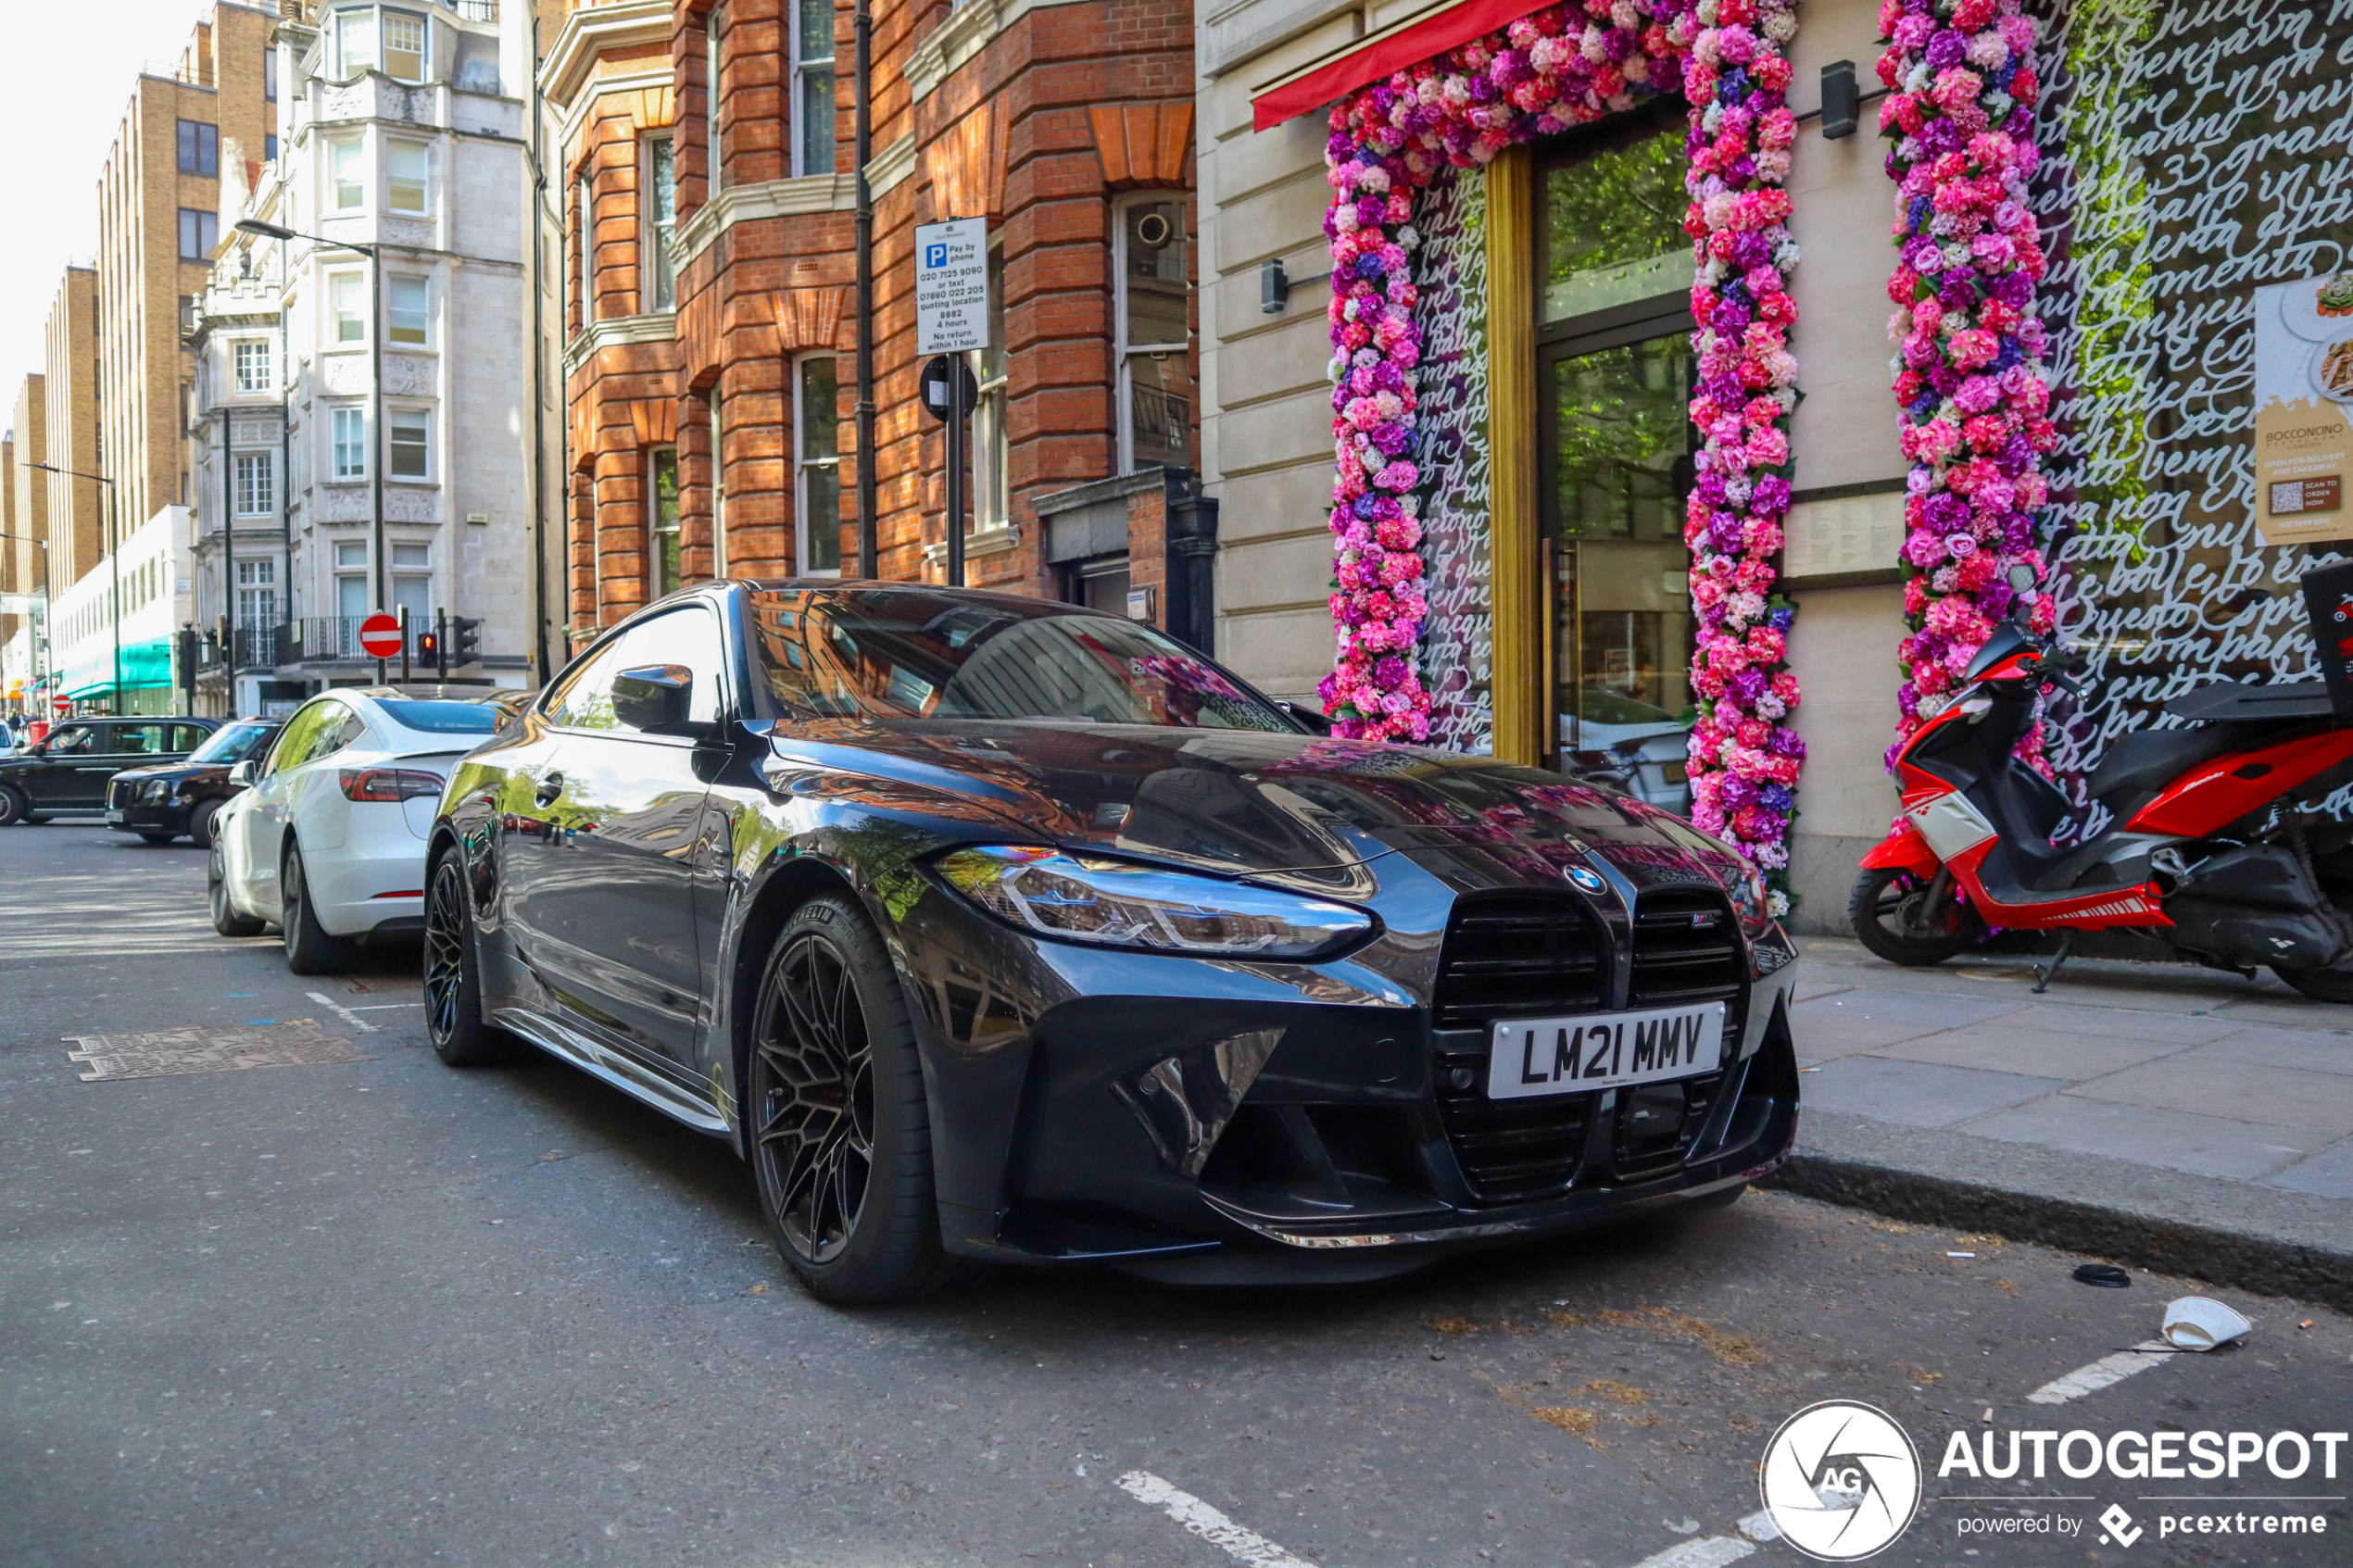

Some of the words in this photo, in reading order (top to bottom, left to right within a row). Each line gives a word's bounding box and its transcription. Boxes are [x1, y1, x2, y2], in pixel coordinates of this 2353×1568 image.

[2224, 48, 2325, 113] non
[930, 246, 945, 267] P
[965, 243, 975, 252] by
[950, 253, 975, 263] phone
[921, 272, 937, 282] 020
[939, 269, 958, 278] 7125
[960, 266, 983, 276] 9090
[949, 278, 965, 287] text
[919, 291, 947, 301] 07860
[949, 289, 965, 298] 022
[967, 285, 984, 295] 205
[920, 299, 950, 310] quoting
[952, 295, 984, 307] location
[939, 309, 963, 319] 8882
[945, 319, 968, 328] hours
[934, 332, 945, 341] No
[947, 329, 973, 339] return
[927, 342, 951, 350] within
[960, 338, 978, 346] hour
[2266, 423, 2344, 443] BOCCONCINO
[2266, 433, 2344, 447] RESTAURANT
[2288, 442, 2322, 450] LONDON
[2264, 459, 2287, 469] OPEN
[2307, 452, 2346, 463] DELIVERY
[2272, 467, 2292, 476] AND
[2293, 462, 2337, 474] TAKEAWAY
[2306, 498, 2324, 507] NOW
[2279, 521, 2293, 529] 020
[2294, 519, 2312, 528] 7499
[1520, 1022, 1624, 1085] LM21
[1631, 1013, 1705, 1073] MMV
